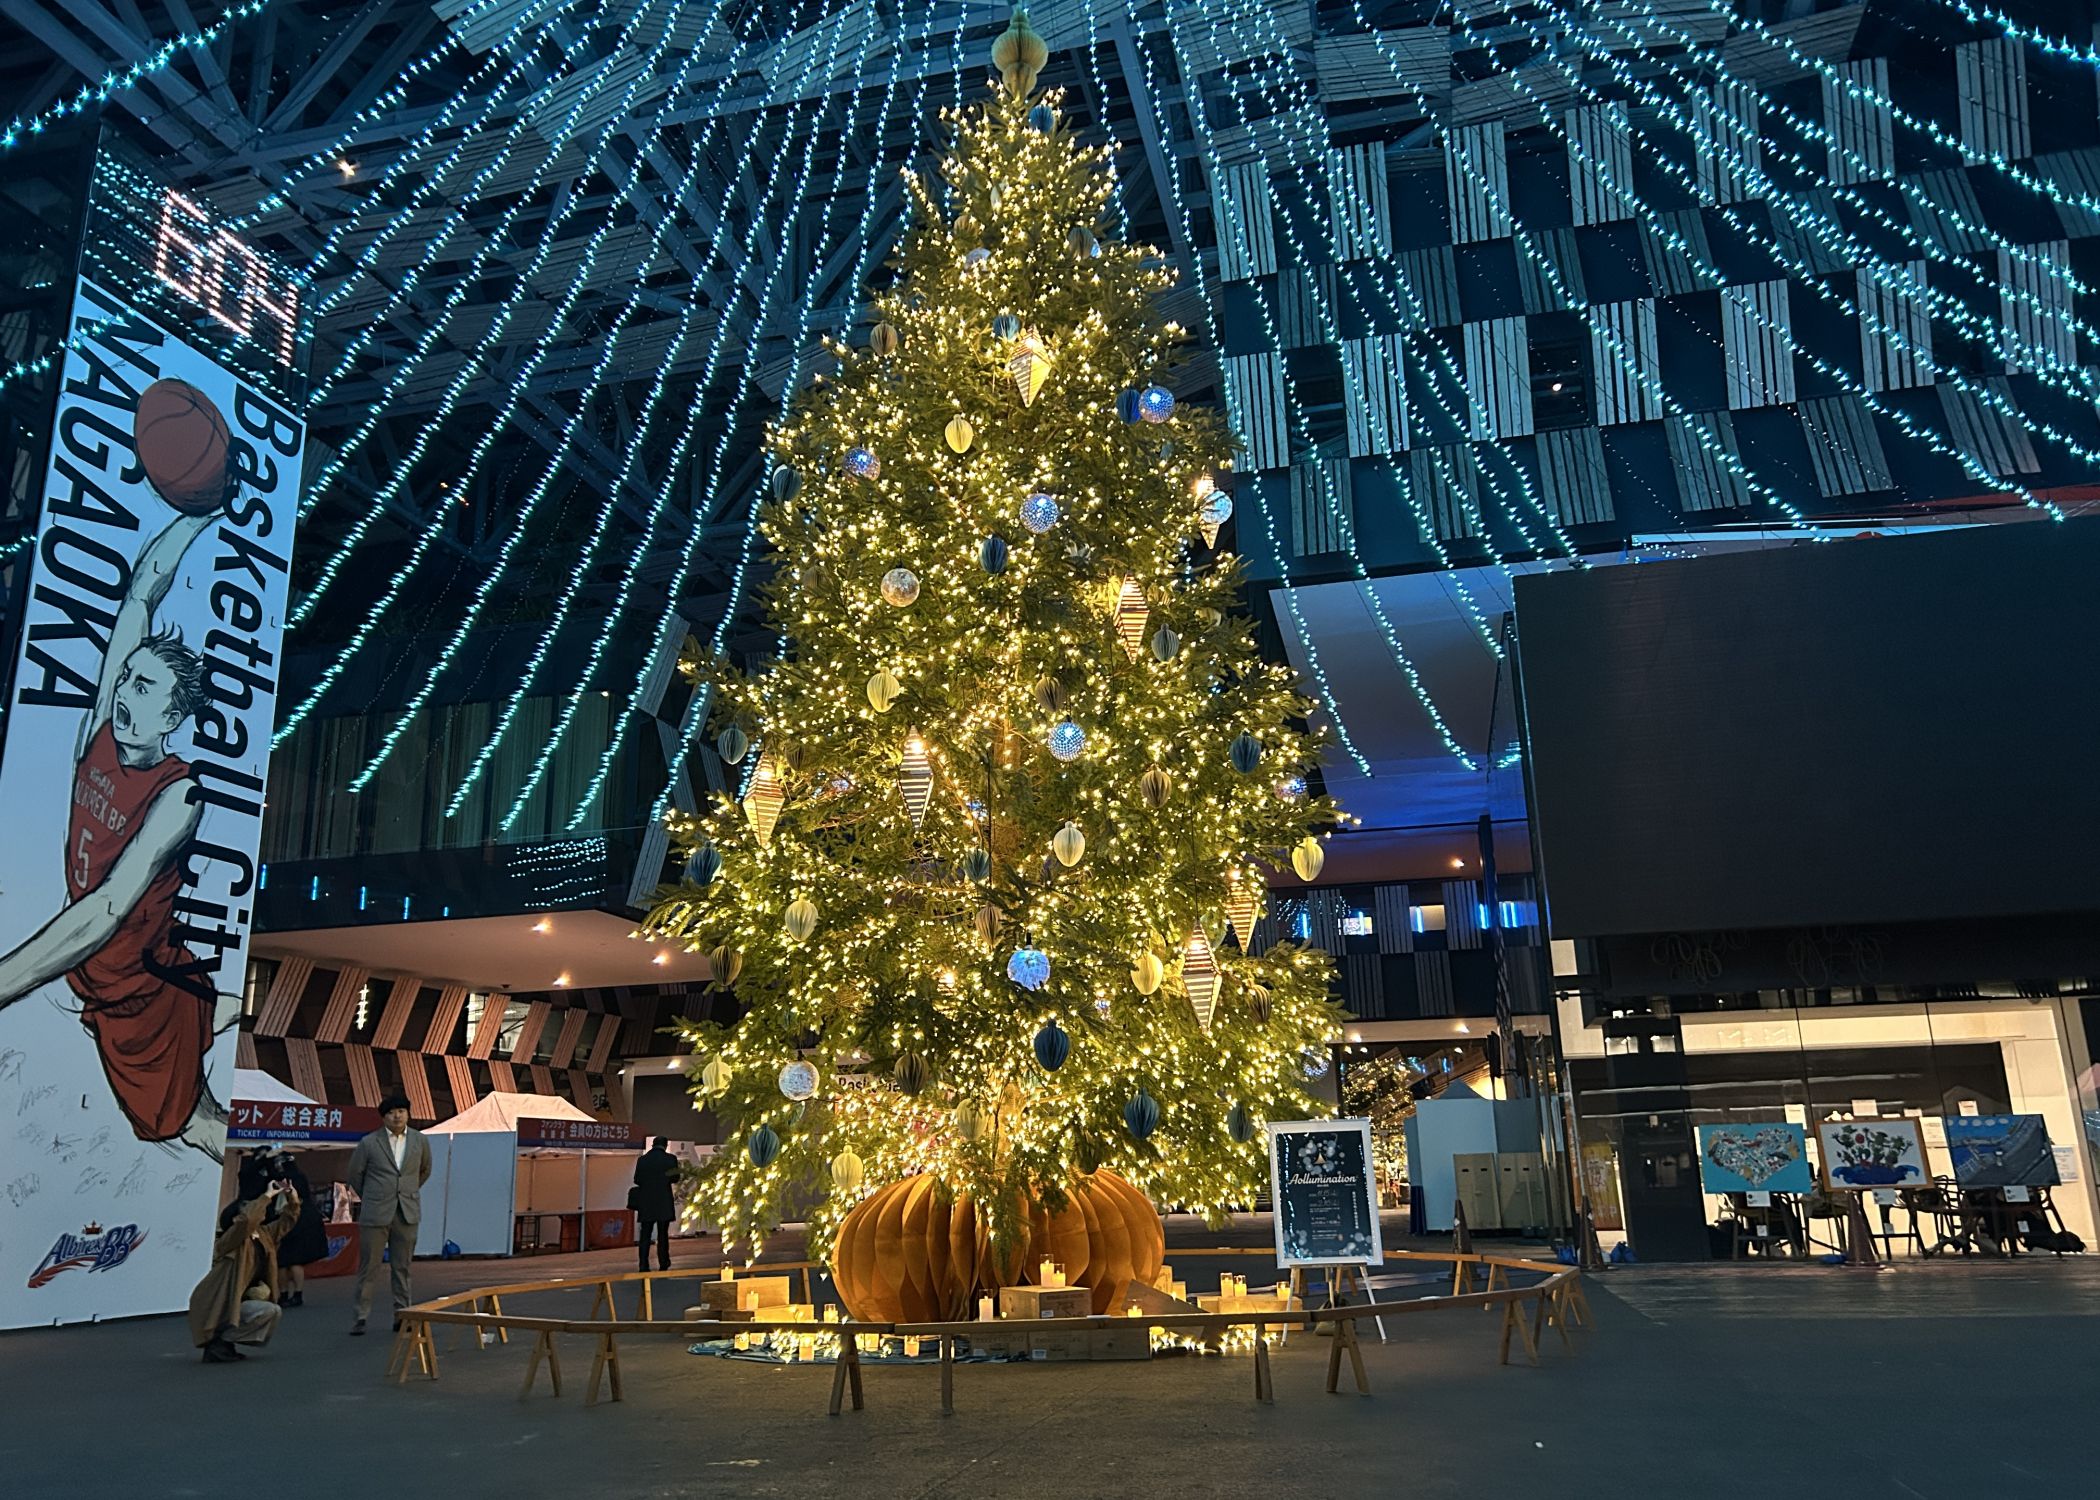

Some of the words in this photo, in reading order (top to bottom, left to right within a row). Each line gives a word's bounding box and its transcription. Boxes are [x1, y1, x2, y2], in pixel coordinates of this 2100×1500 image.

[18, 280, 165, 710] NAGAOKA
[184, 383, 303, 819] Basketball
[75, 827, 93, 889] 5
[142, 839, 254, 1000] City
[1288, 1173, 1357, 1185] Aollumination
